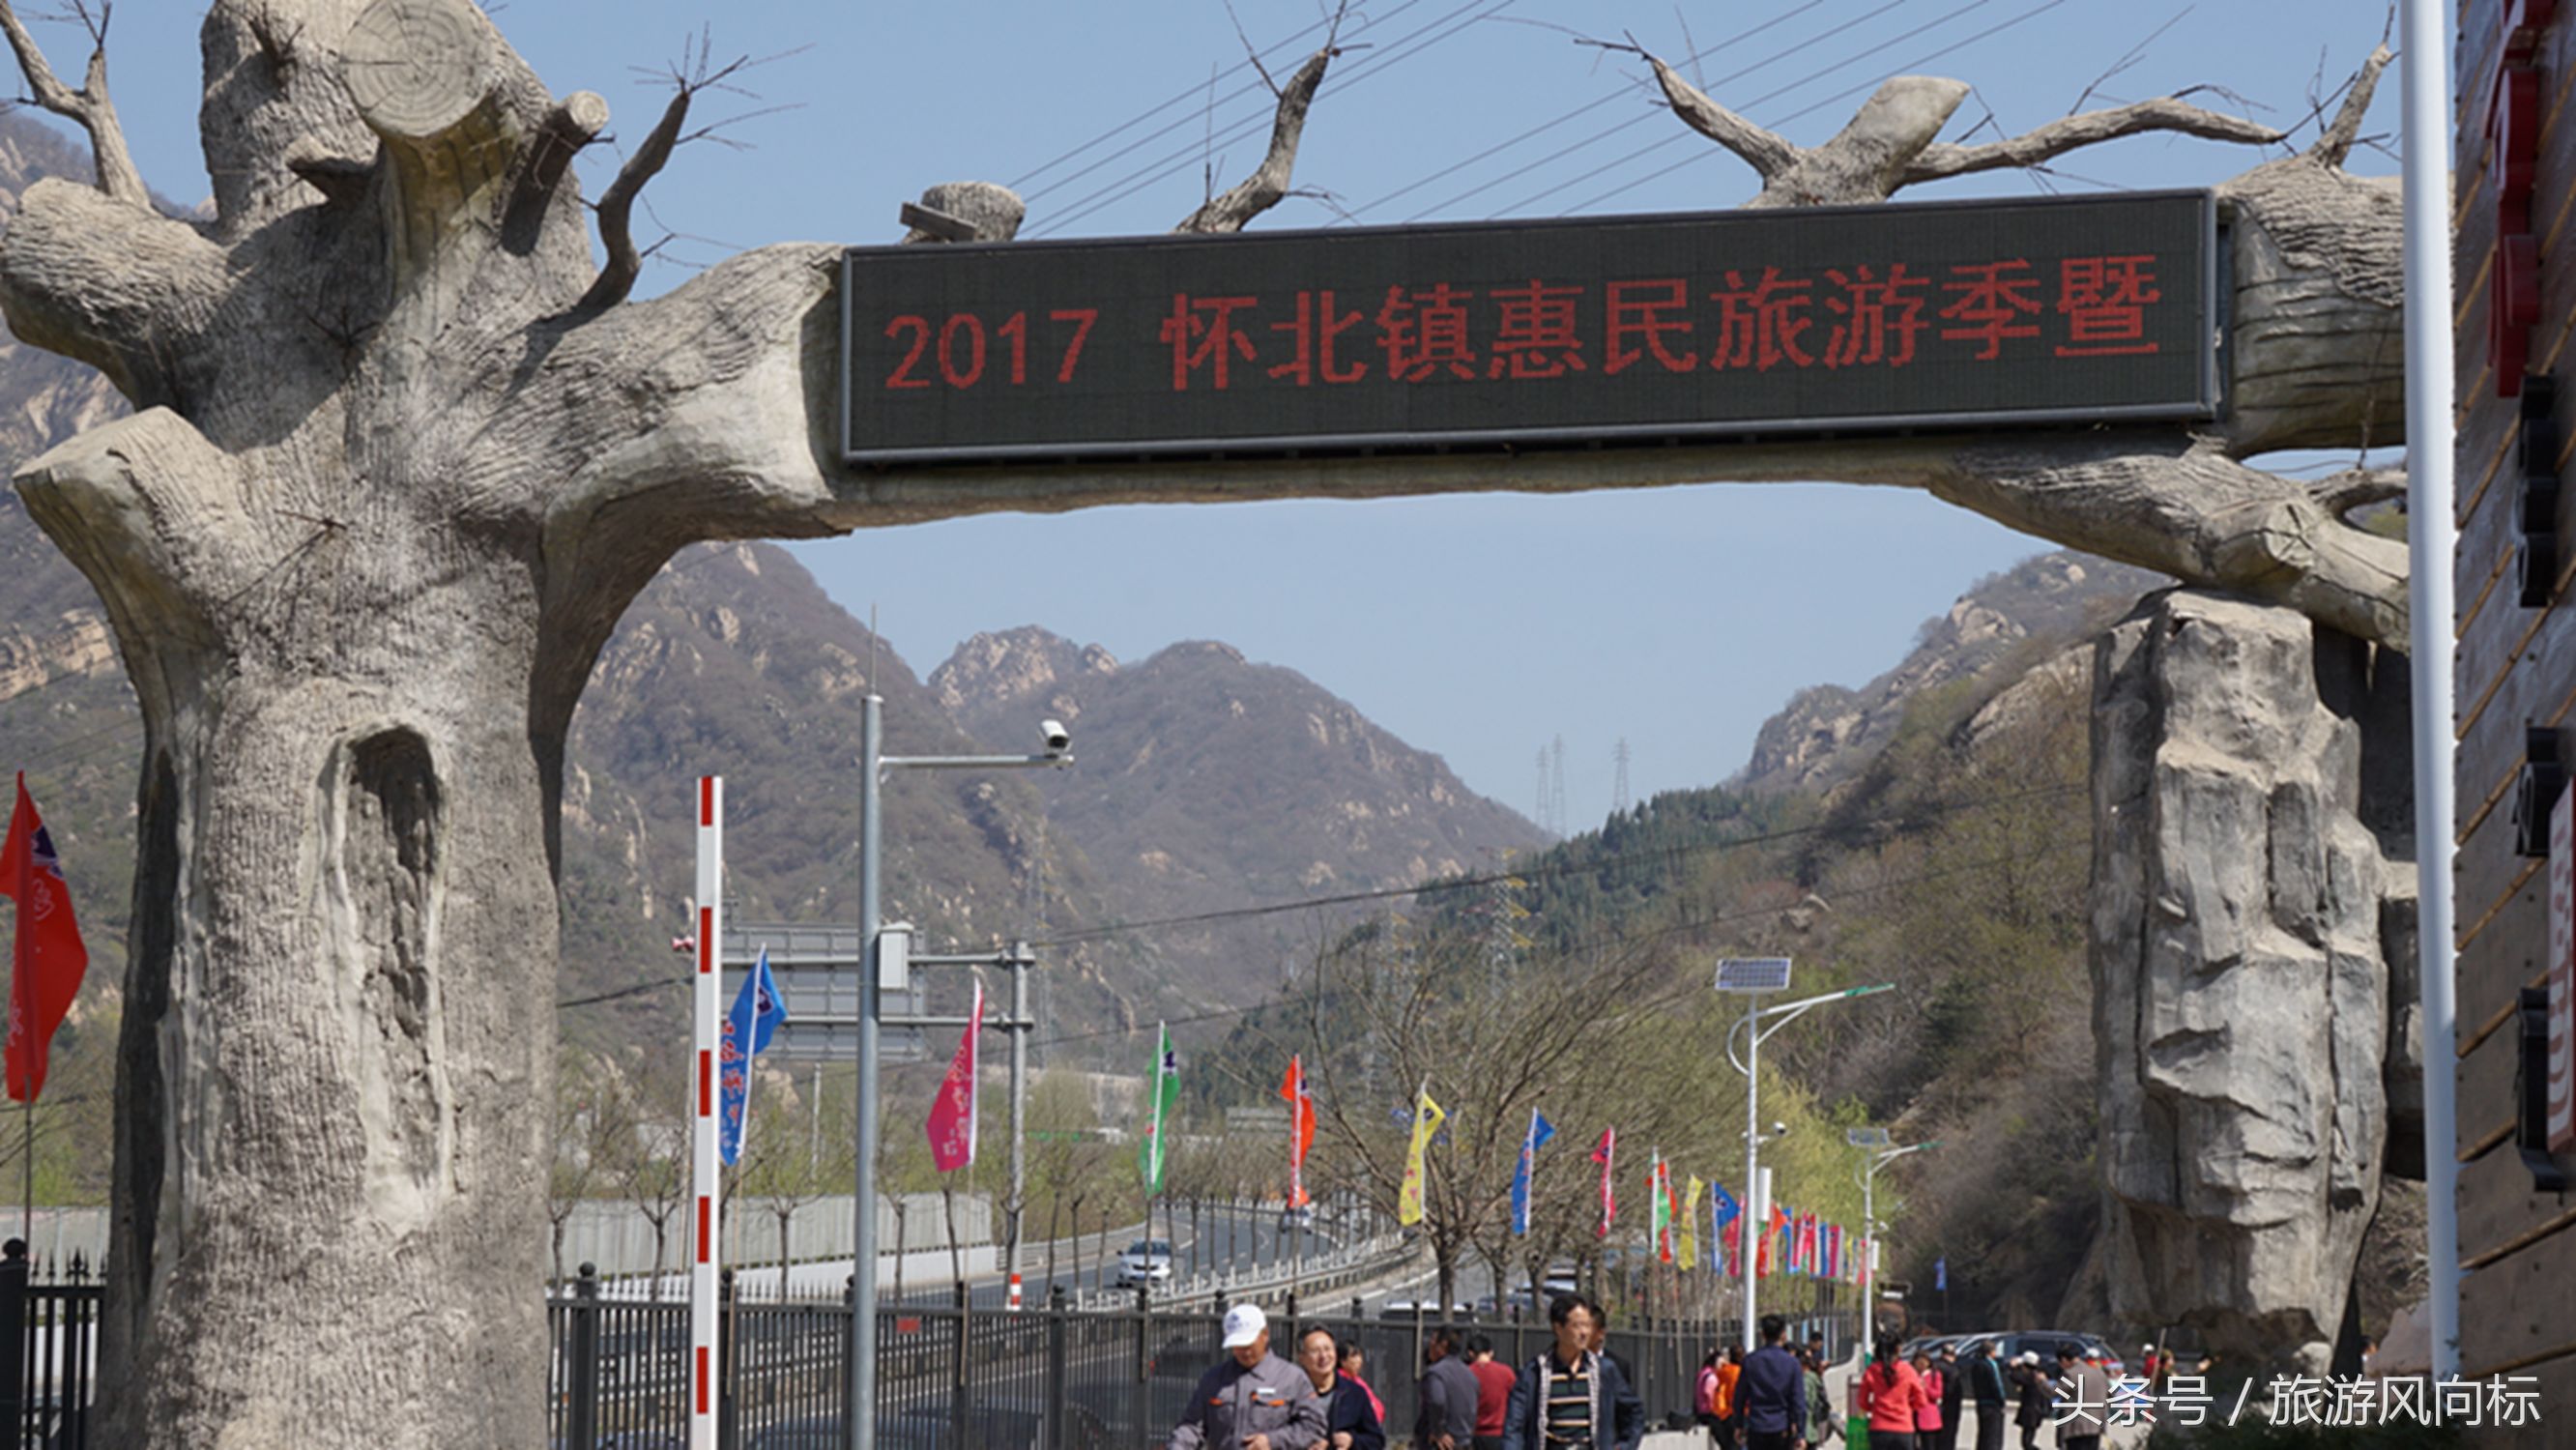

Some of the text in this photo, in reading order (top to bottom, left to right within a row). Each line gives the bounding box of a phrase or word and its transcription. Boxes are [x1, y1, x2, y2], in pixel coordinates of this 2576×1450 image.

[885, 253, 2162, 391] 2017 怀北镇惠民旅游季暨
